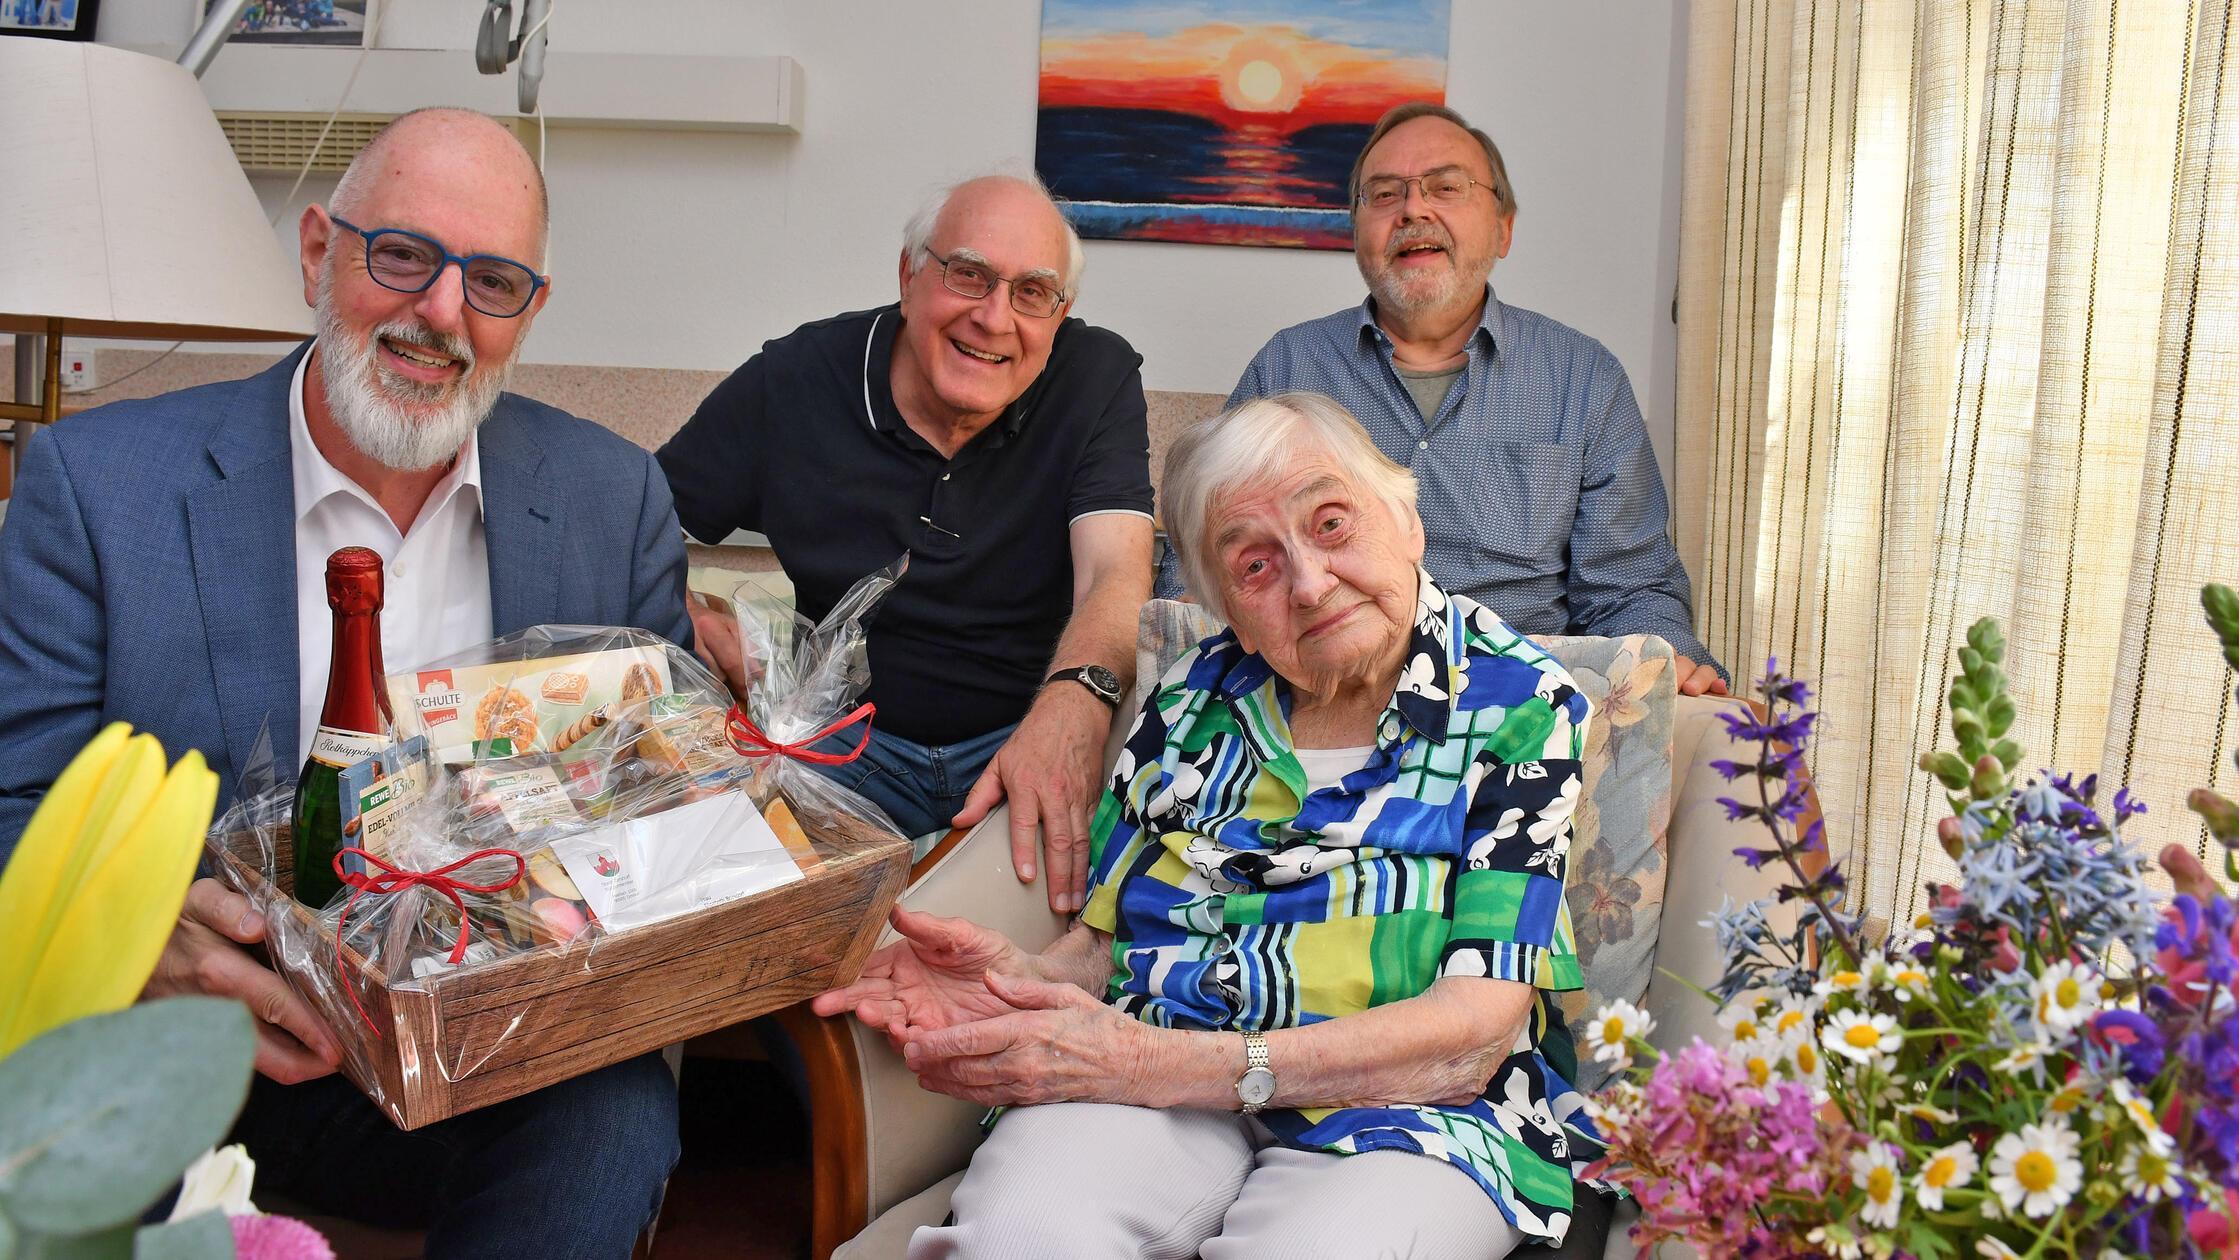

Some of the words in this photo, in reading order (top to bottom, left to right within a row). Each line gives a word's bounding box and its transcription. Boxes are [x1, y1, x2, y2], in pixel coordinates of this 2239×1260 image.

[415, 693, 462, 708] SCHULTE
[369, 789, 391, 807] REWE
[390, 777, 416, 800] Bio
